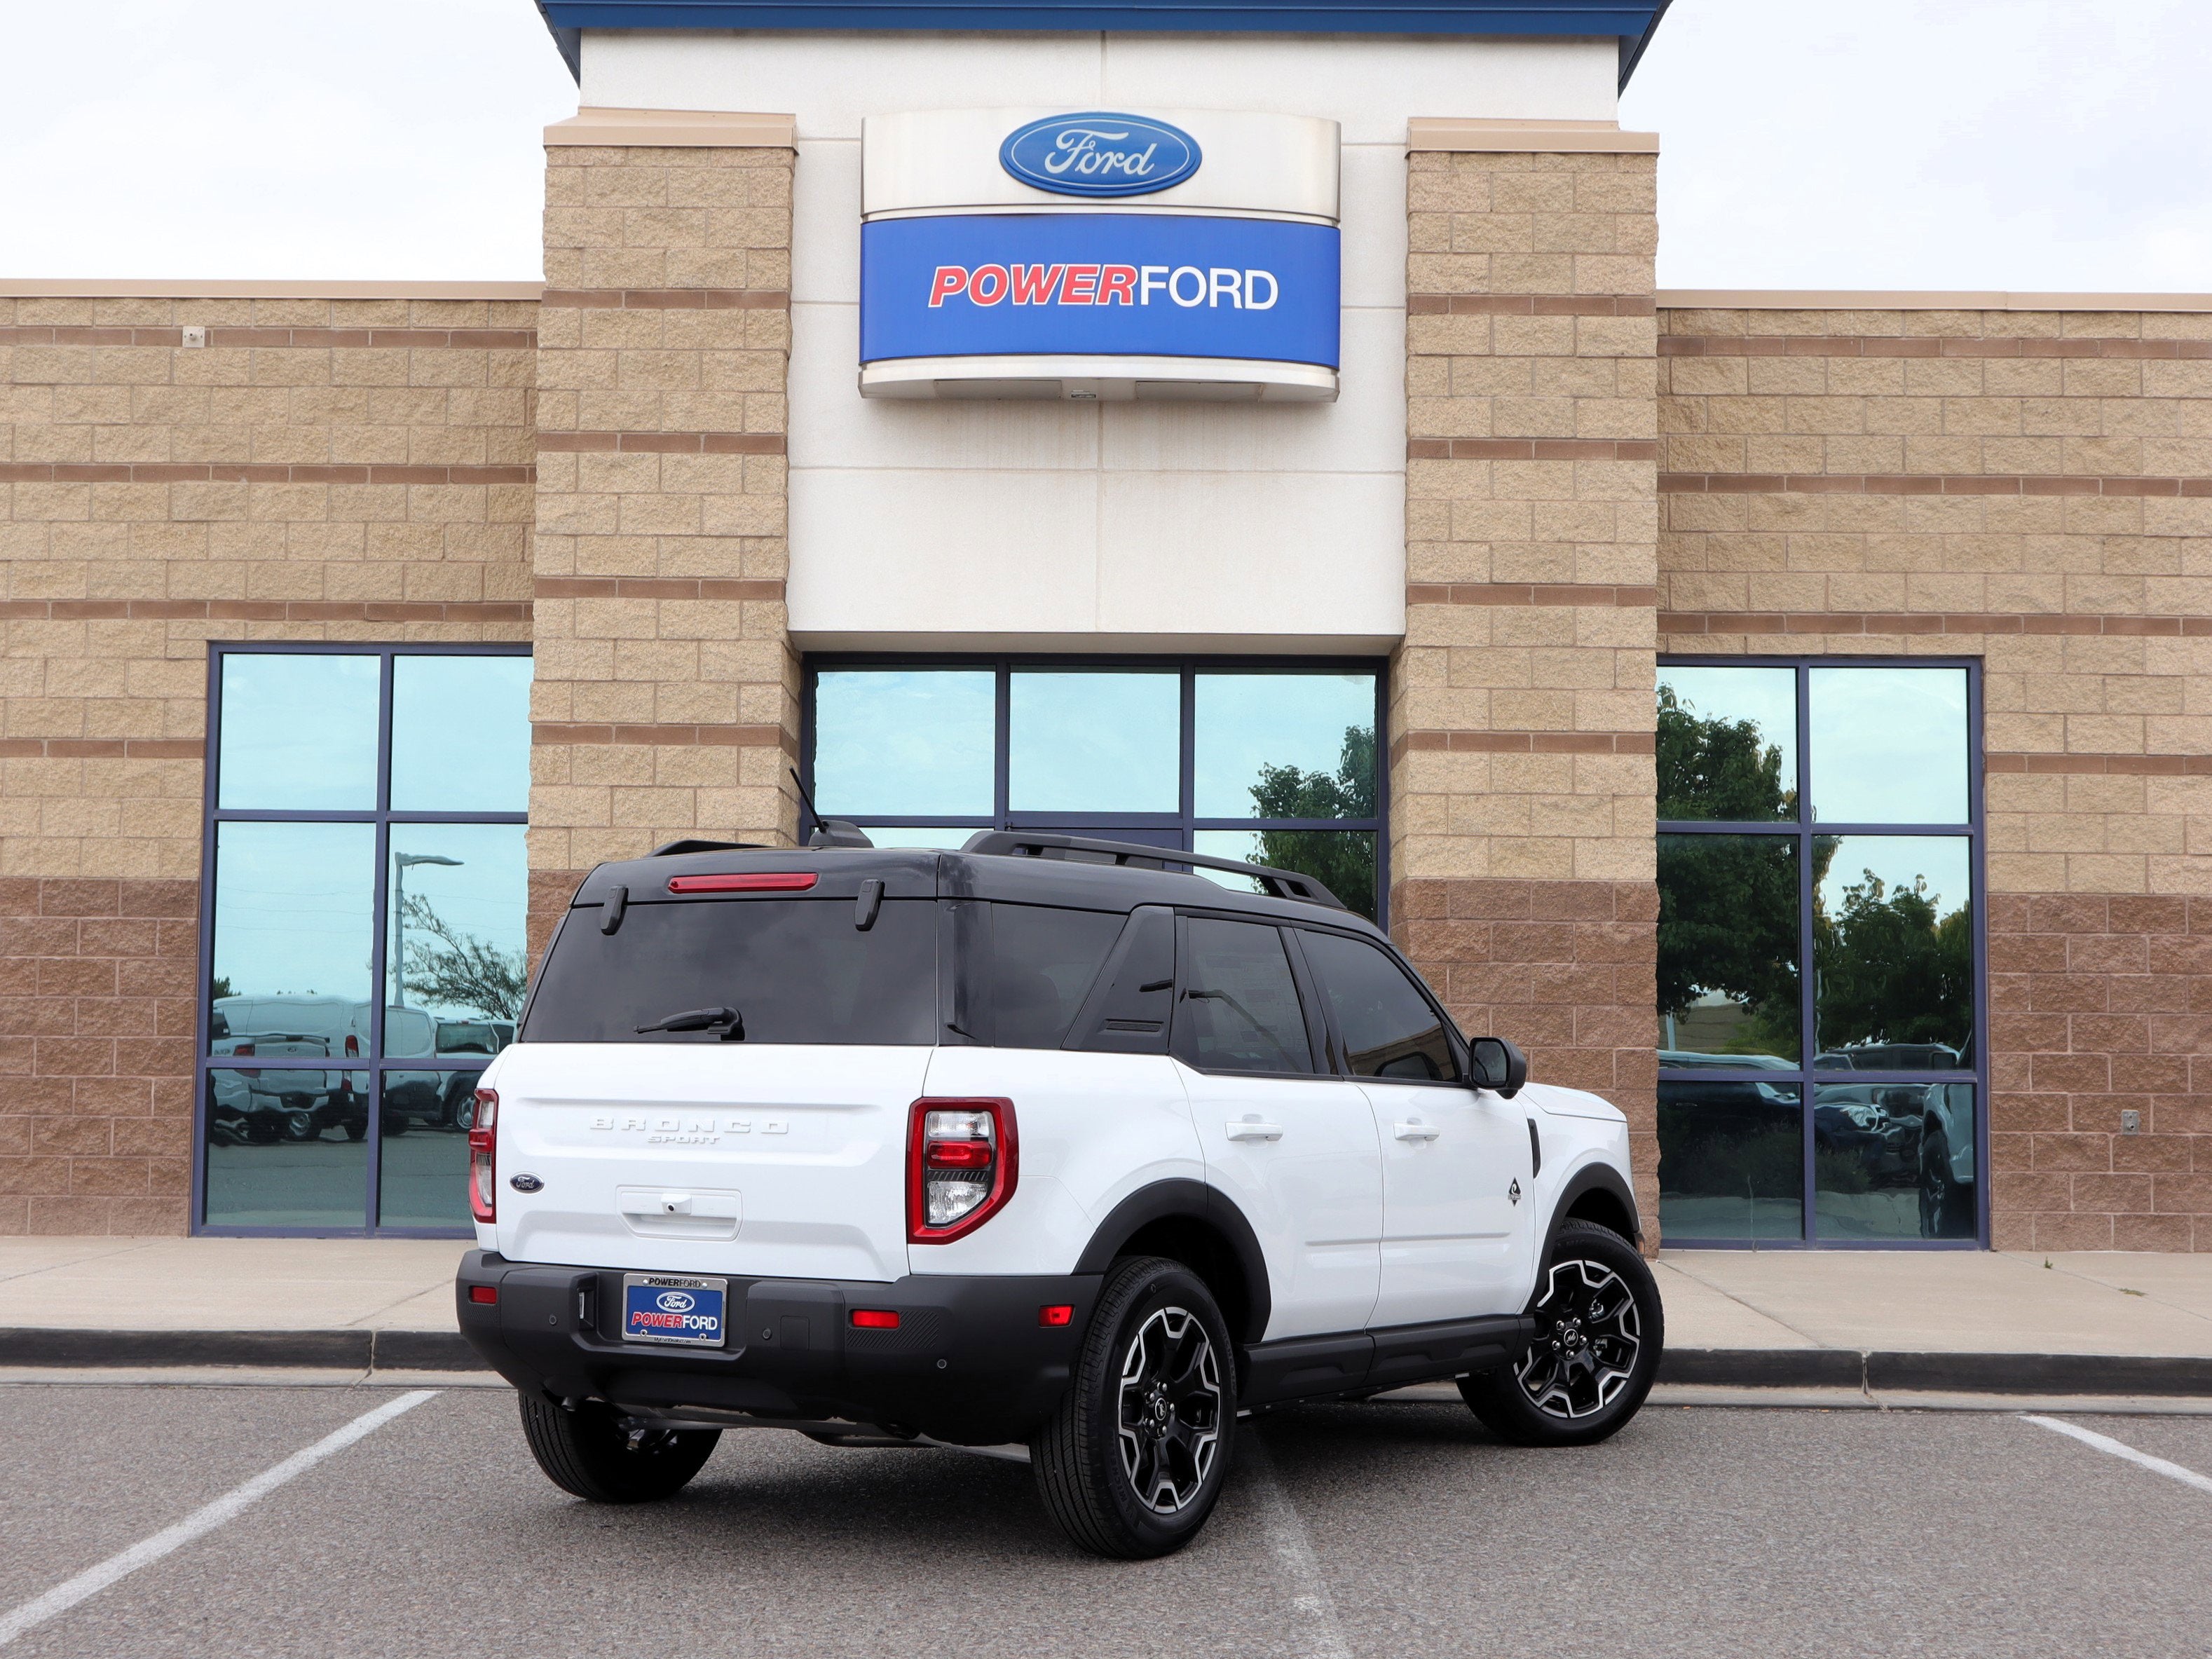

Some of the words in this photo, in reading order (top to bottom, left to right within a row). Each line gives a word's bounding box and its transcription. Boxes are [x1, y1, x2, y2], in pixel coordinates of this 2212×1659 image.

[1045, 128, 1157, 175] Ford
[589, 1117, 788, 1134] BRONCO
[647, 1136, 721, 1145] SPORT
[516, 1176, 535, 1189] Ford
[664, 1295, 688, 1309] Ford
